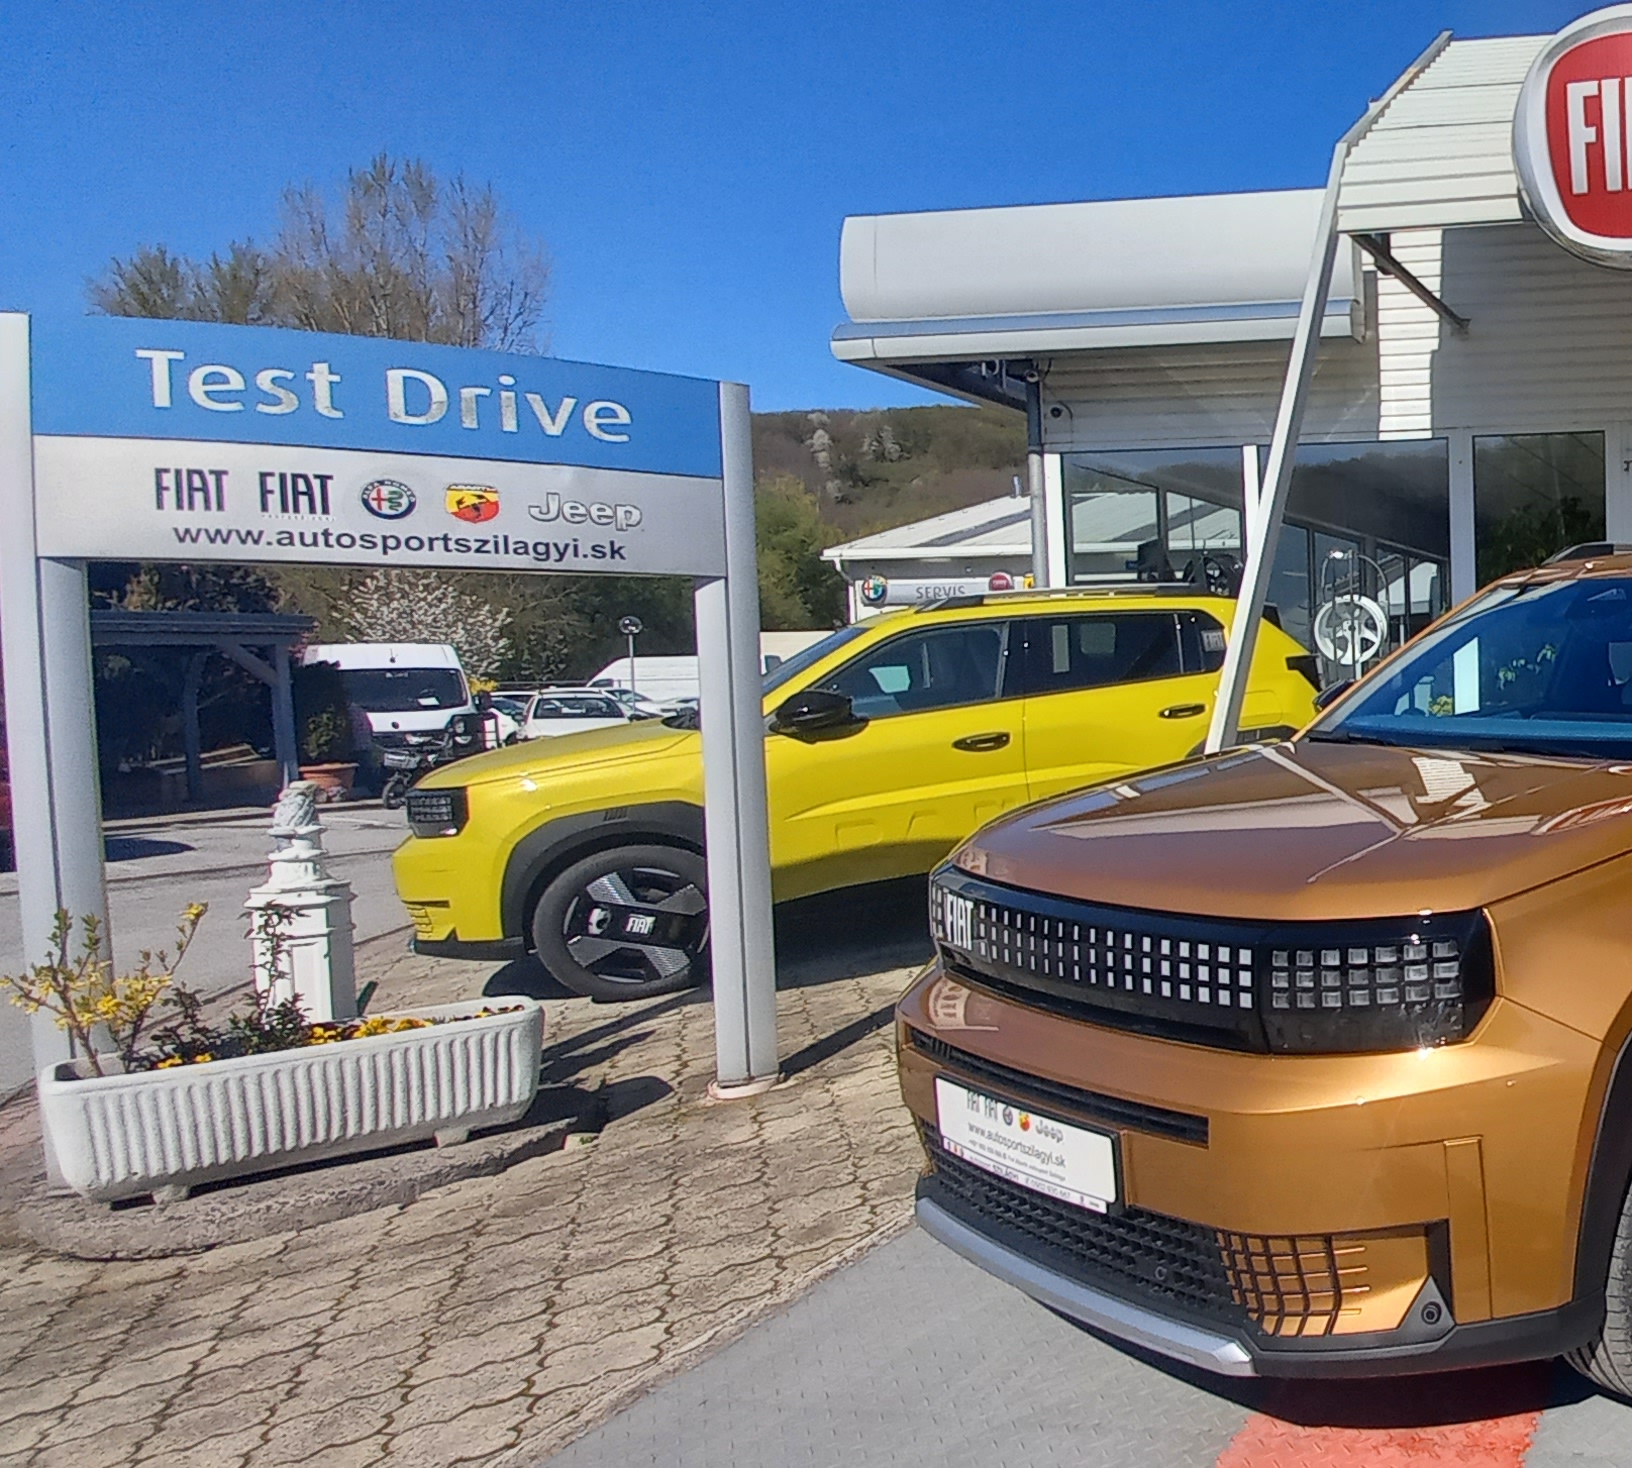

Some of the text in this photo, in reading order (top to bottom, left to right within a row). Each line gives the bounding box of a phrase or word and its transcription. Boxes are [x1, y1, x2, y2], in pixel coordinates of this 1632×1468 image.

[135, 348, 632, 443] Test Drive
[154, 467, 334, 516] FIAT FIAT
[528, 491, 642, 532] Jeep
[172, 526, 627, 563] www.autosportszilagyi.sk
[915, 585, 966, 600] SERVIS
[625, 914, 656, 935] FIAT
[946, 892, 974, 951] FIAT
